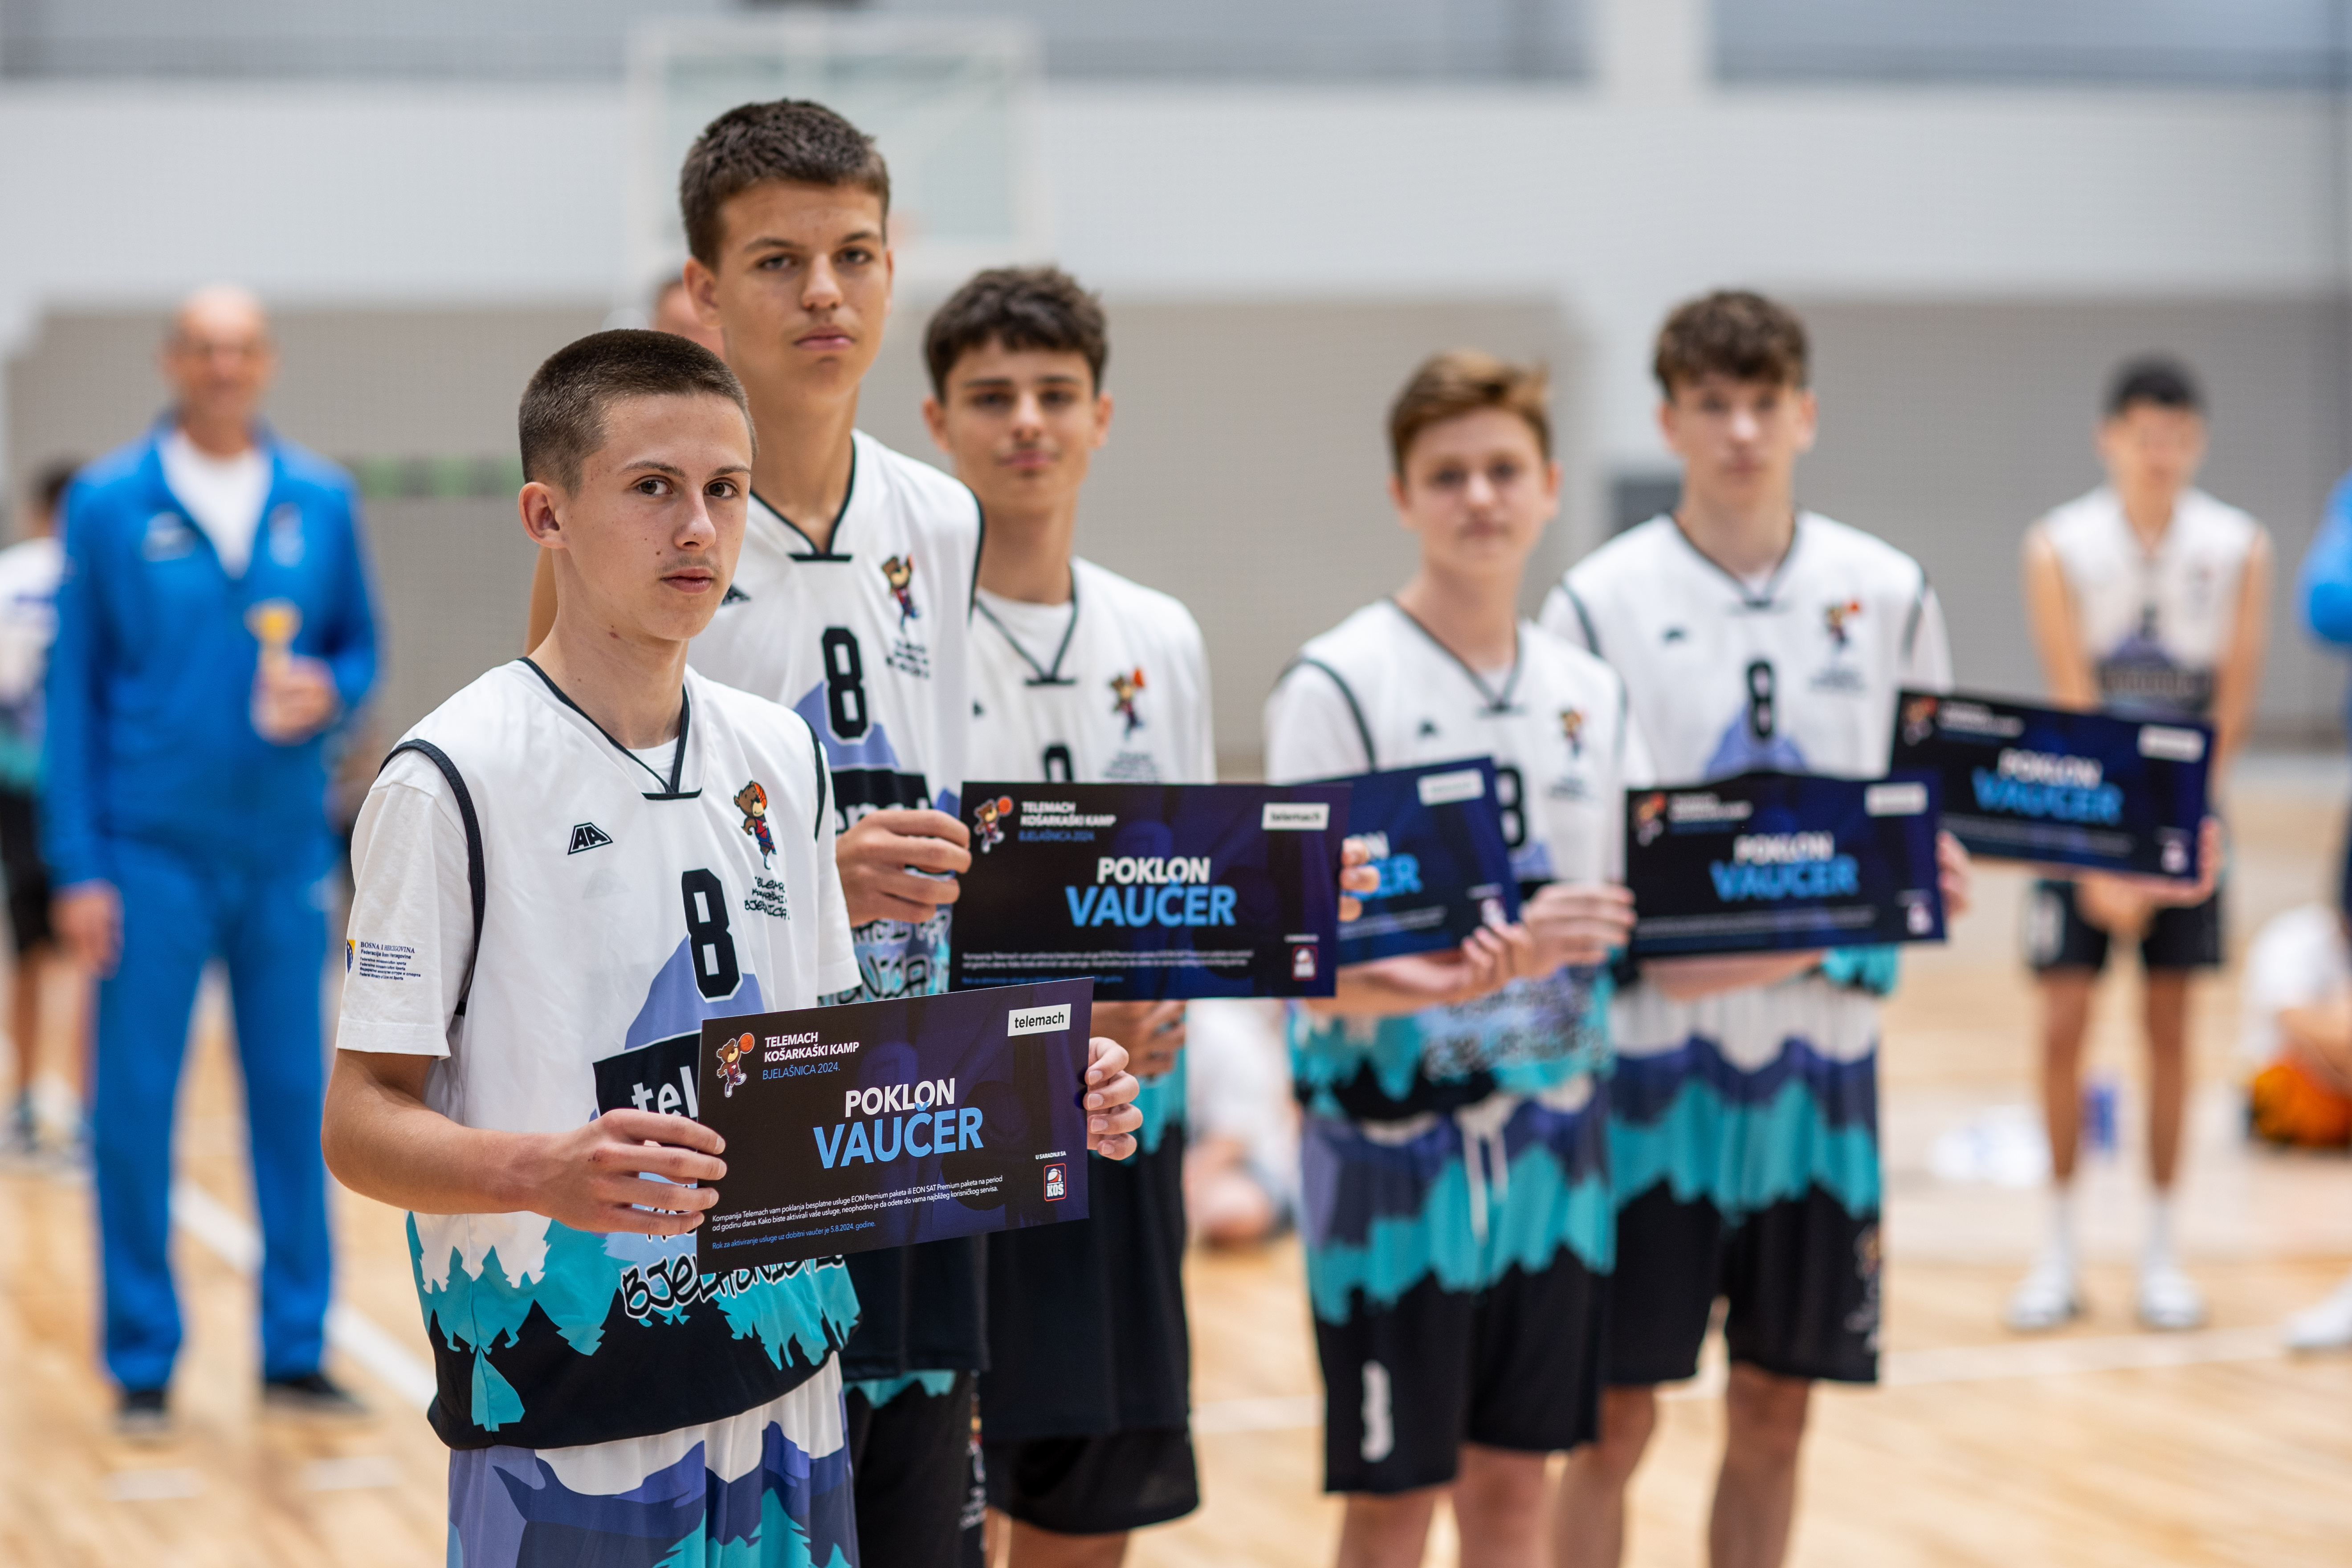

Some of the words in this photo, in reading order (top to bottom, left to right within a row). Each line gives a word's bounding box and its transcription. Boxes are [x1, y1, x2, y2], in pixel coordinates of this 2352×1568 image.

[821, 626, 867, 738] 8
[1733, 831, 1834, 866] POKLON
[1097, 857, 1211, 884] POKLON
[360, 941, 379, 950] BOSNA
[681, 868, 740, 998] 8
[1015, 1011, 1064, 1028] telemach
[764, 1043, 827, 1062] KOŠARKAŠKI
[830, 1042, 859, 1055] KAMP
[765, 1032, 818, 1047] TELEMACH
[763, 1064, 816, 1079] BJELAŠNICA
[818, 1062, 840, 1073] 2024.
[845, 1078, 955, 1117] POKLON
[813, 1102, 984, 1169] VAUČER
[712, 1212, 742, 1222] Kompanija
[742, 1208, 768, 1218] Telemach
[782, 1203, 804, 1214] poklanja
[806, 1200, 832, 1210] besplatne
[833, 1197, 850, 1206] usluge
[851, 1194, 864, 1203] EON
[865, 1192, 888, 1201] Premium
[889, 1189, 906, 1199] paketa
[913, 1186, 925, 1194] EON
[926, 1184, 937, 1192] SAT
[937, 1182, 960, 1191] Premium
[960, 1180, 978, 1189] paketa
[986, 1175, 1003, 1185] period
[712, 1223, 720, 1231] od
[721, 1222, 741, 1232] godinu
[758, 1217, 772, 1225] Kako
[787, 1211, 808, 1221] aktivirali
[822, 1208, 841, 1216] usluge,
[842, 1203, 873, 1214] neophodno
[873, 1202, 879, 1210] je
[927, 1192, 950, 1202] najbližeg
[950, 1188, 979, 1197] korisničkog
[980, 1185, 998, 1193] servisa.
[712, 1241, 723, 1249] Rok
[731, 1237, 758, 1247] aktiviranje
[759, 1235, 777, 1243] usluge
[786, 1230, 805, 1239] dobitni
[806, 1228, 824, 1236] vaučer
[824, 1227, 829, 1235] je
[831, 1223, 855, 1233] 5.8.2024.
[856, 1221, 876, 1231] godine.
